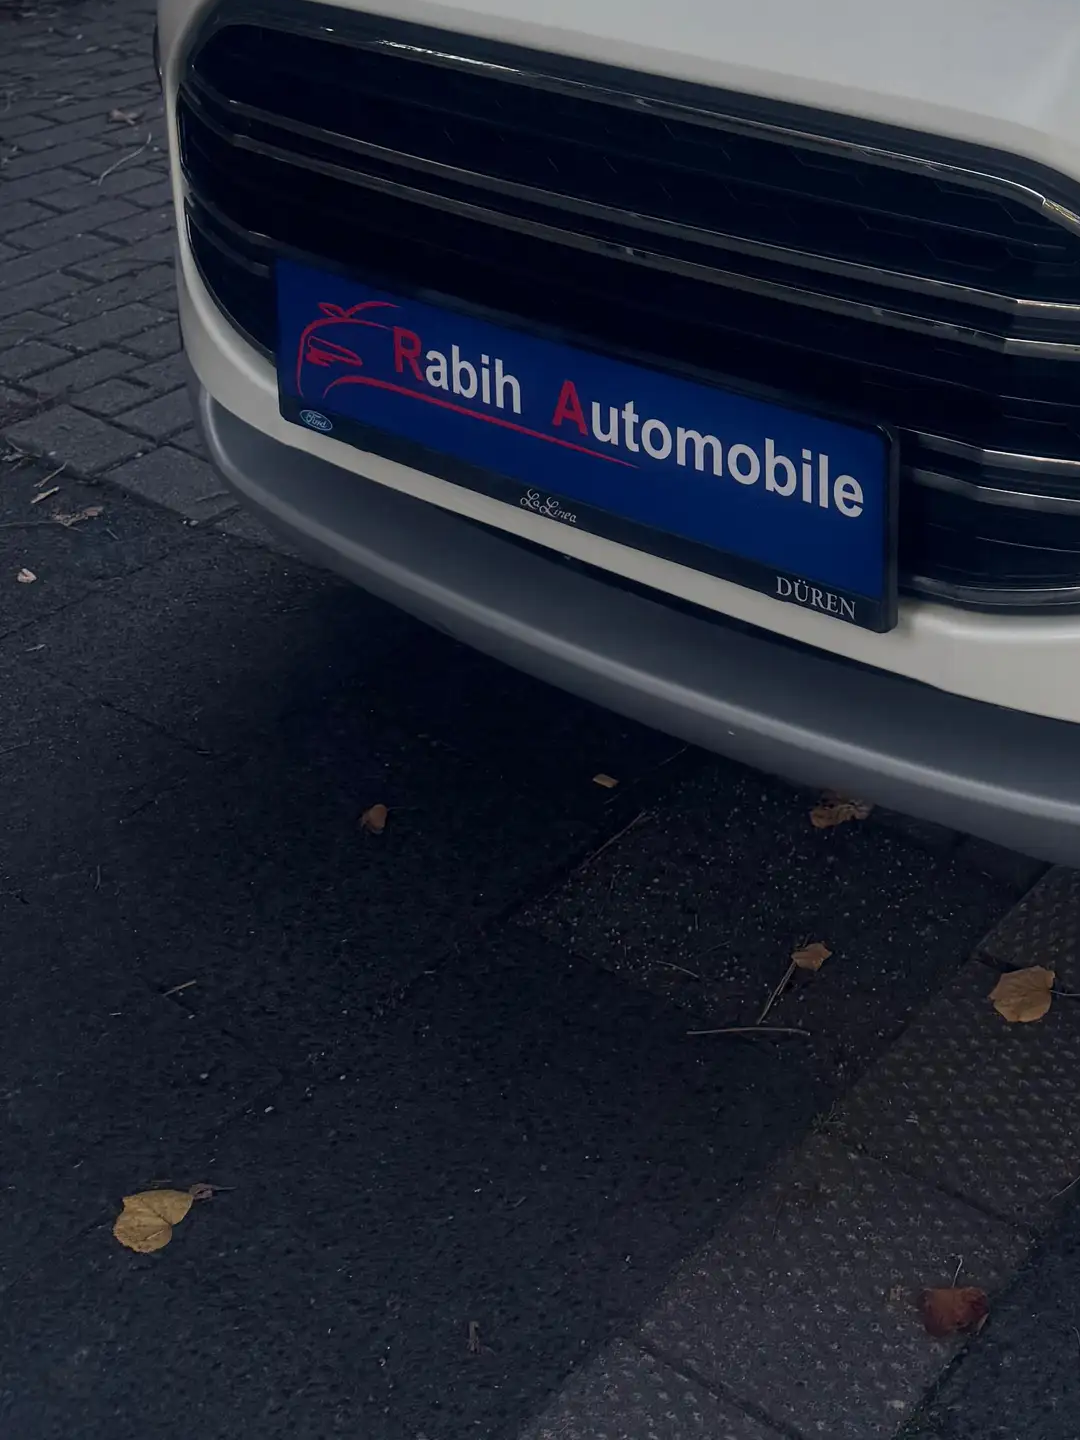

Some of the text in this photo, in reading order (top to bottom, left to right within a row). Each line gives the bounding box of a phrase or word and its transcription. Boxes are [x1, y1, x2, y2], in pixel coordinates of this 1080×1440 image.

[305, 411, 329, 429] Ford
[393, 325, 864, 518] Rabih Automobile
[776, 575, 856, 620] DÜREN
